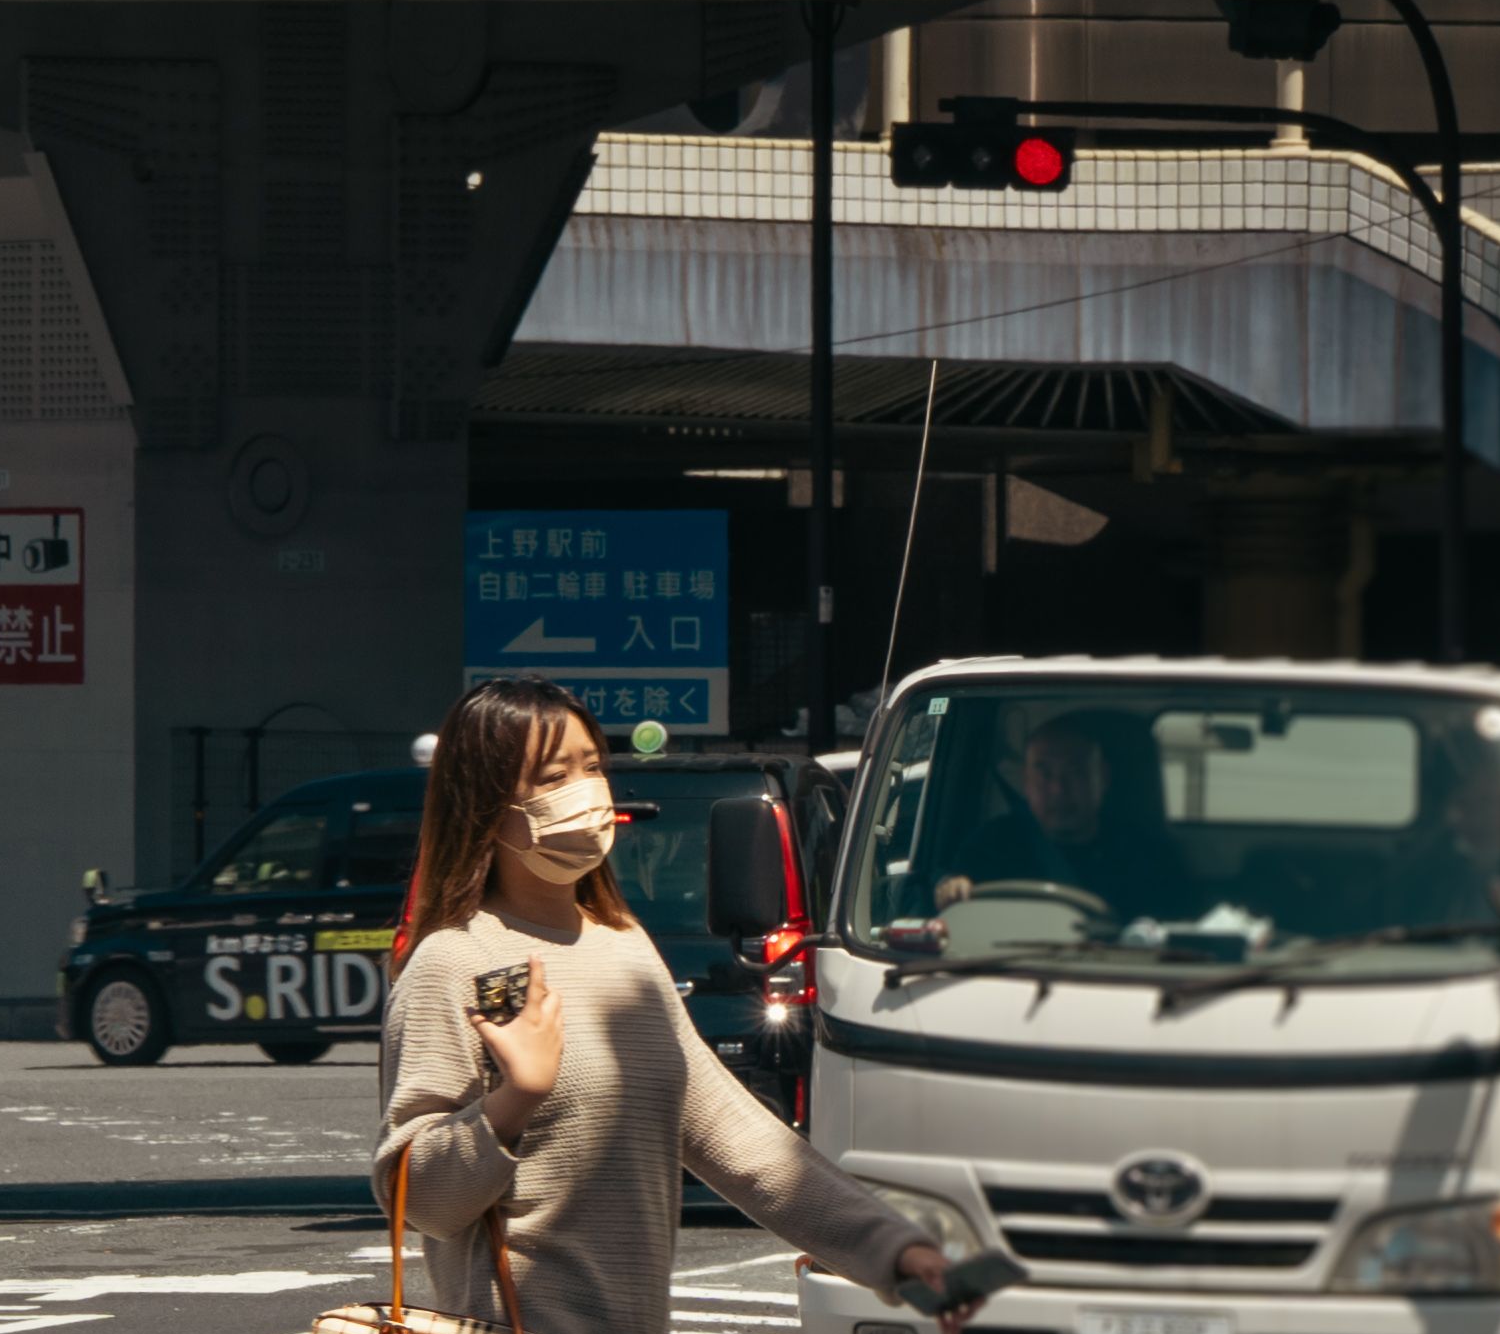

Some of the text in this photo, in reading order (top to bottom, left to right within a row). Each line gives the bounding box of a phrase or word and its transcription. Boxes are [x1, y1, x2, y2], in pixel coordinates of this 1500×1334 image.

[478, 528, 607, 559] 上野駅前
[478, 570, 716, 601] 自動二輪車 駐車場
[622, 615, 701, 652] 入口
[567, 686, 697, 717] 付を除く
[204, 953, 394, 1021] S.RID
